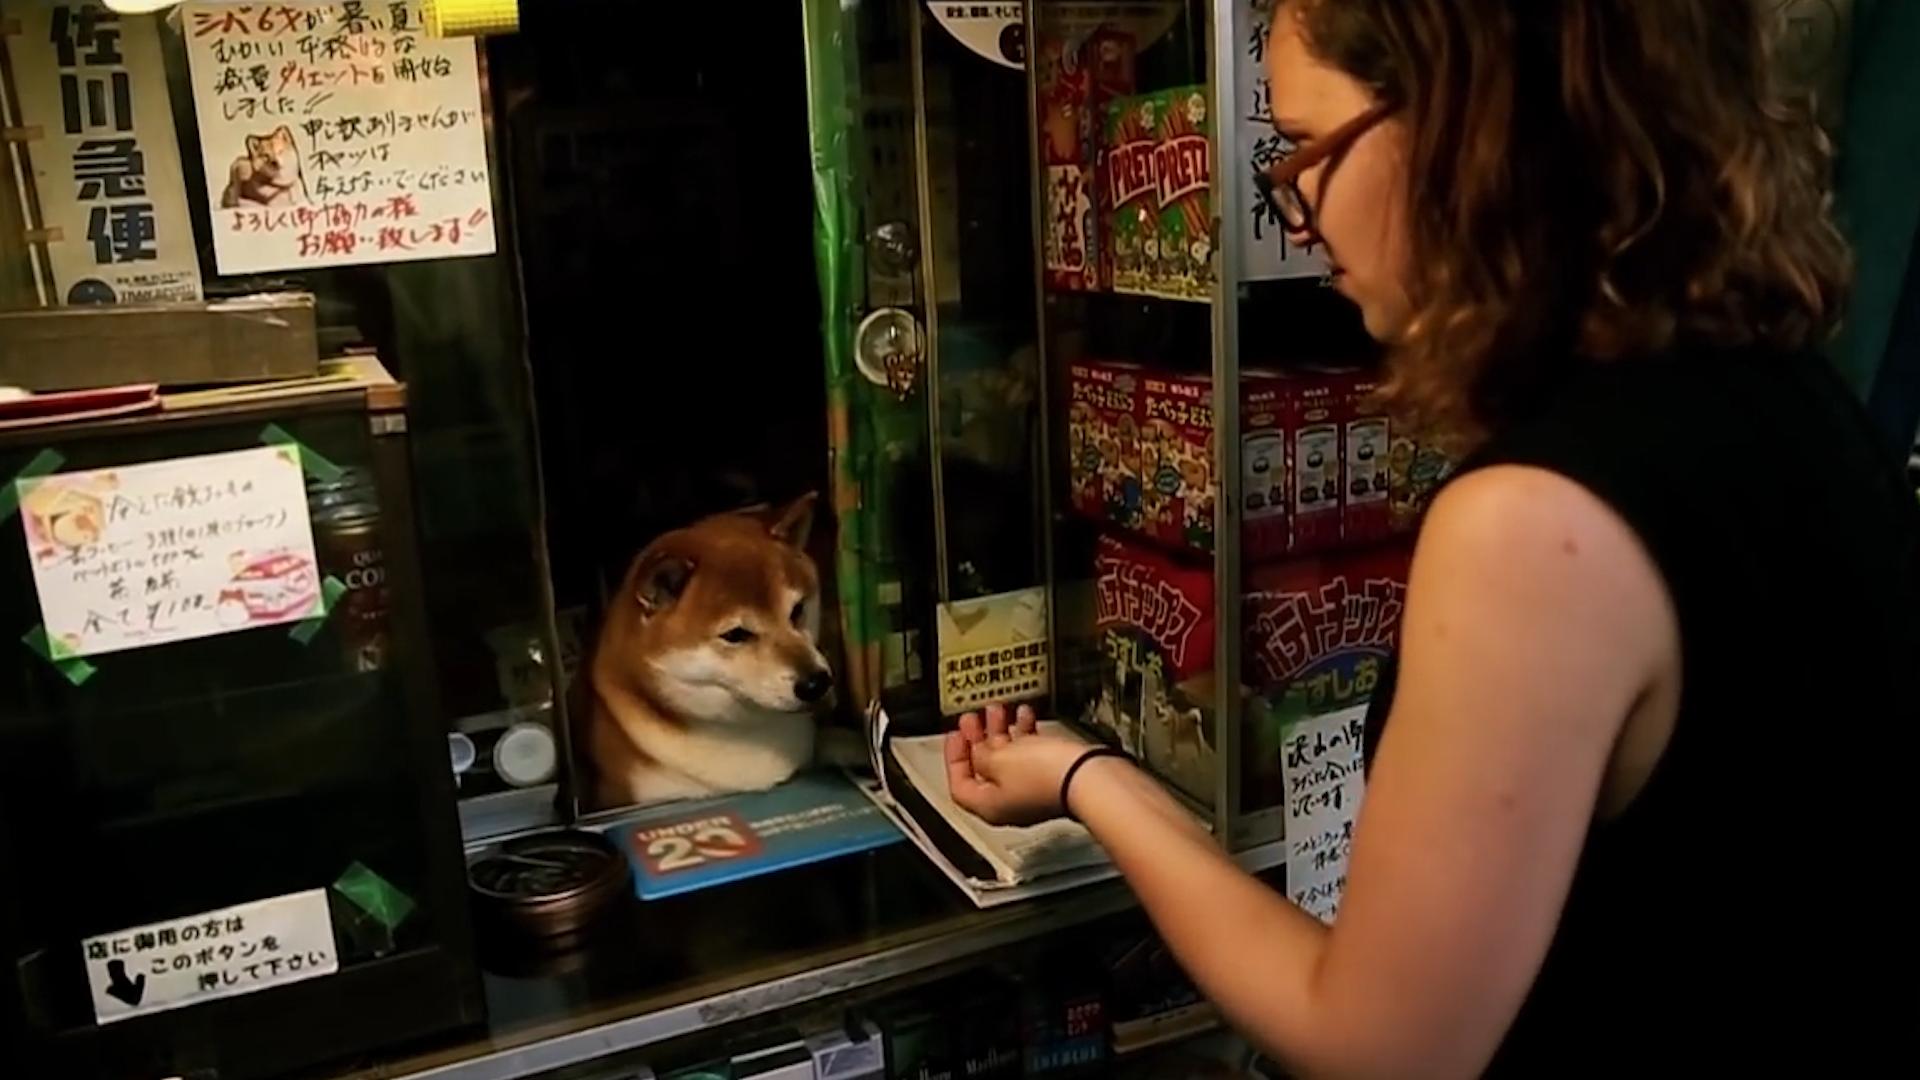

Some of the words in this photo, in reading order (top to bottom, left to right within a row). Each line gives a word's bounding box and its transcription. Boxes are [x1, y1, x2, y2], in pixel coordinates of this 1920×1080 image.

[51, 5, 157, 264] 佐川急便
[1110, 140, 1155, 198] PRET
[637, 815, 733, 842] UNDER
[647, 826, 746, 872] 20
[88, 915, 244, 960] 店に御用の方は
[151, 935, 281, 975] このボタンを
[198, 951, 326, 991] 押して下さい
